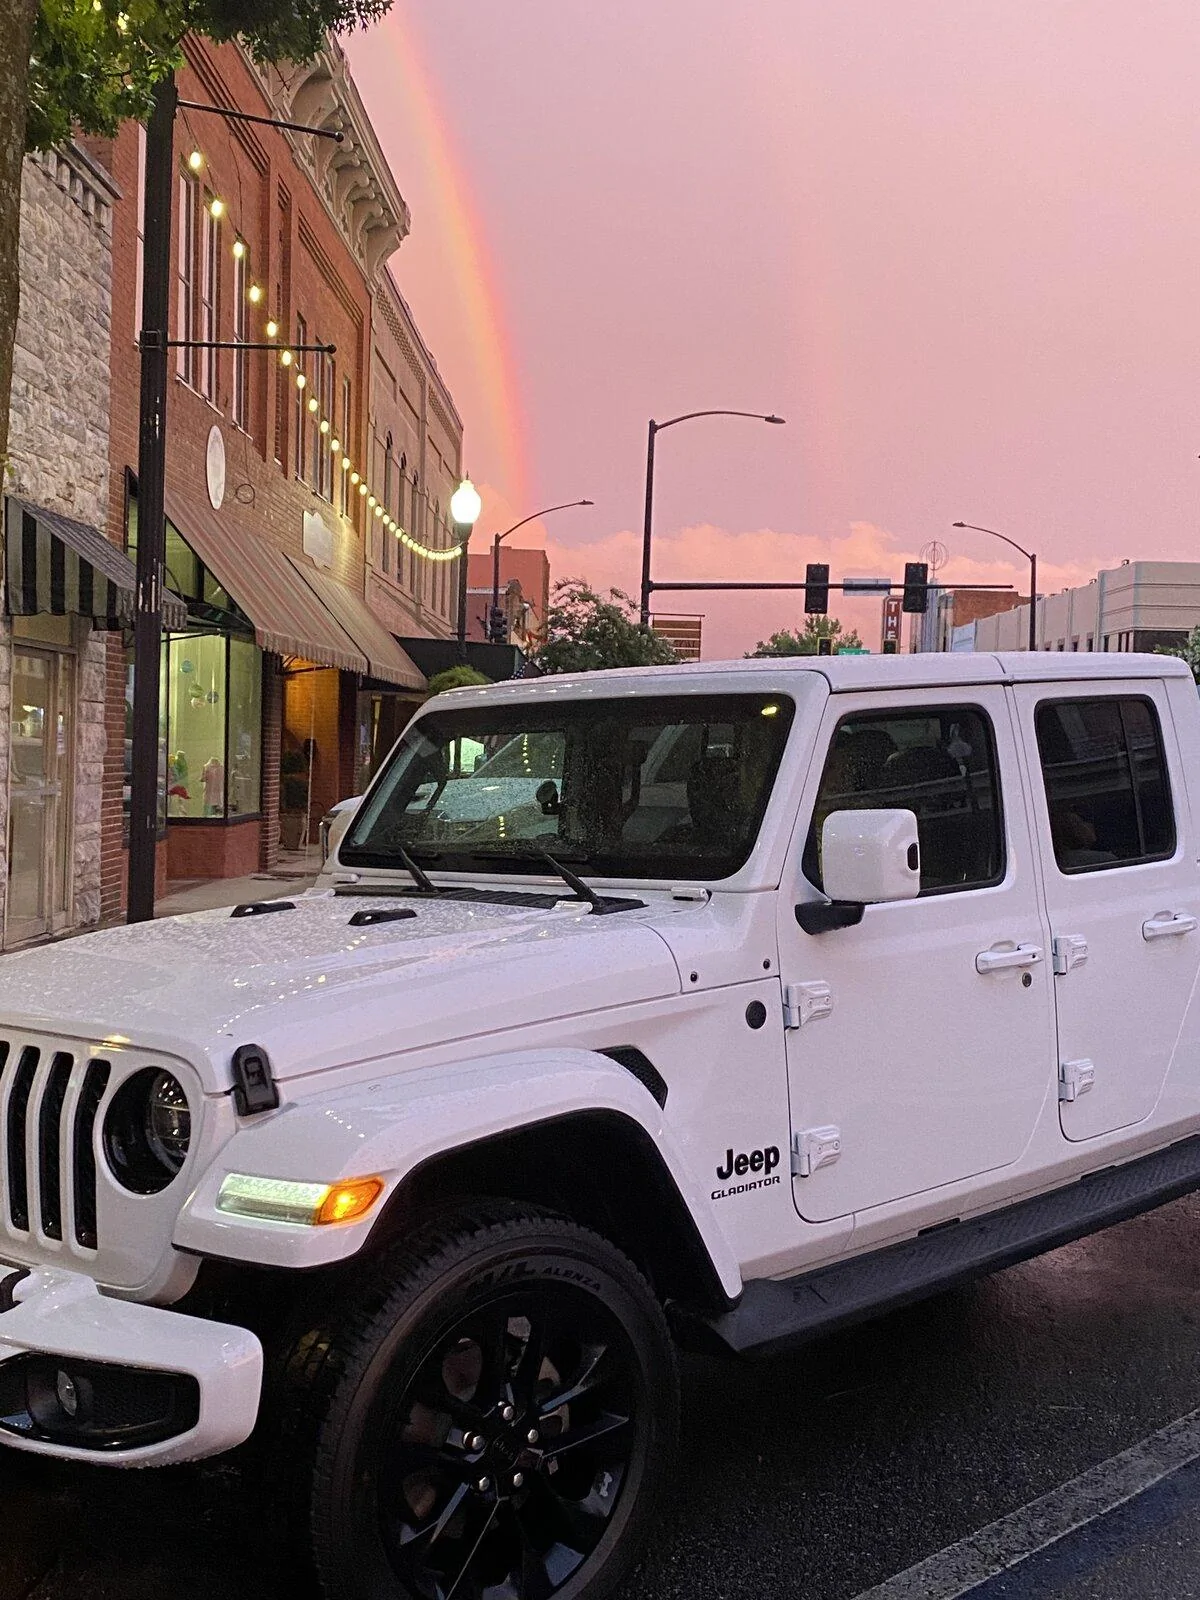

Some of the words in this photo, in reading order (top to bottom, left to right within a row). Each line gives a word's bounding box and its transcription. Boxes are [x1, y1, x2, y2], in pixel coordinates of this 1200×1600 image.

[716, 1145, 780, 1180] Jeep
[710, 1175, 781, 1200] GLADIATOR
[541, 1266, 601, 1292] ALENZA
